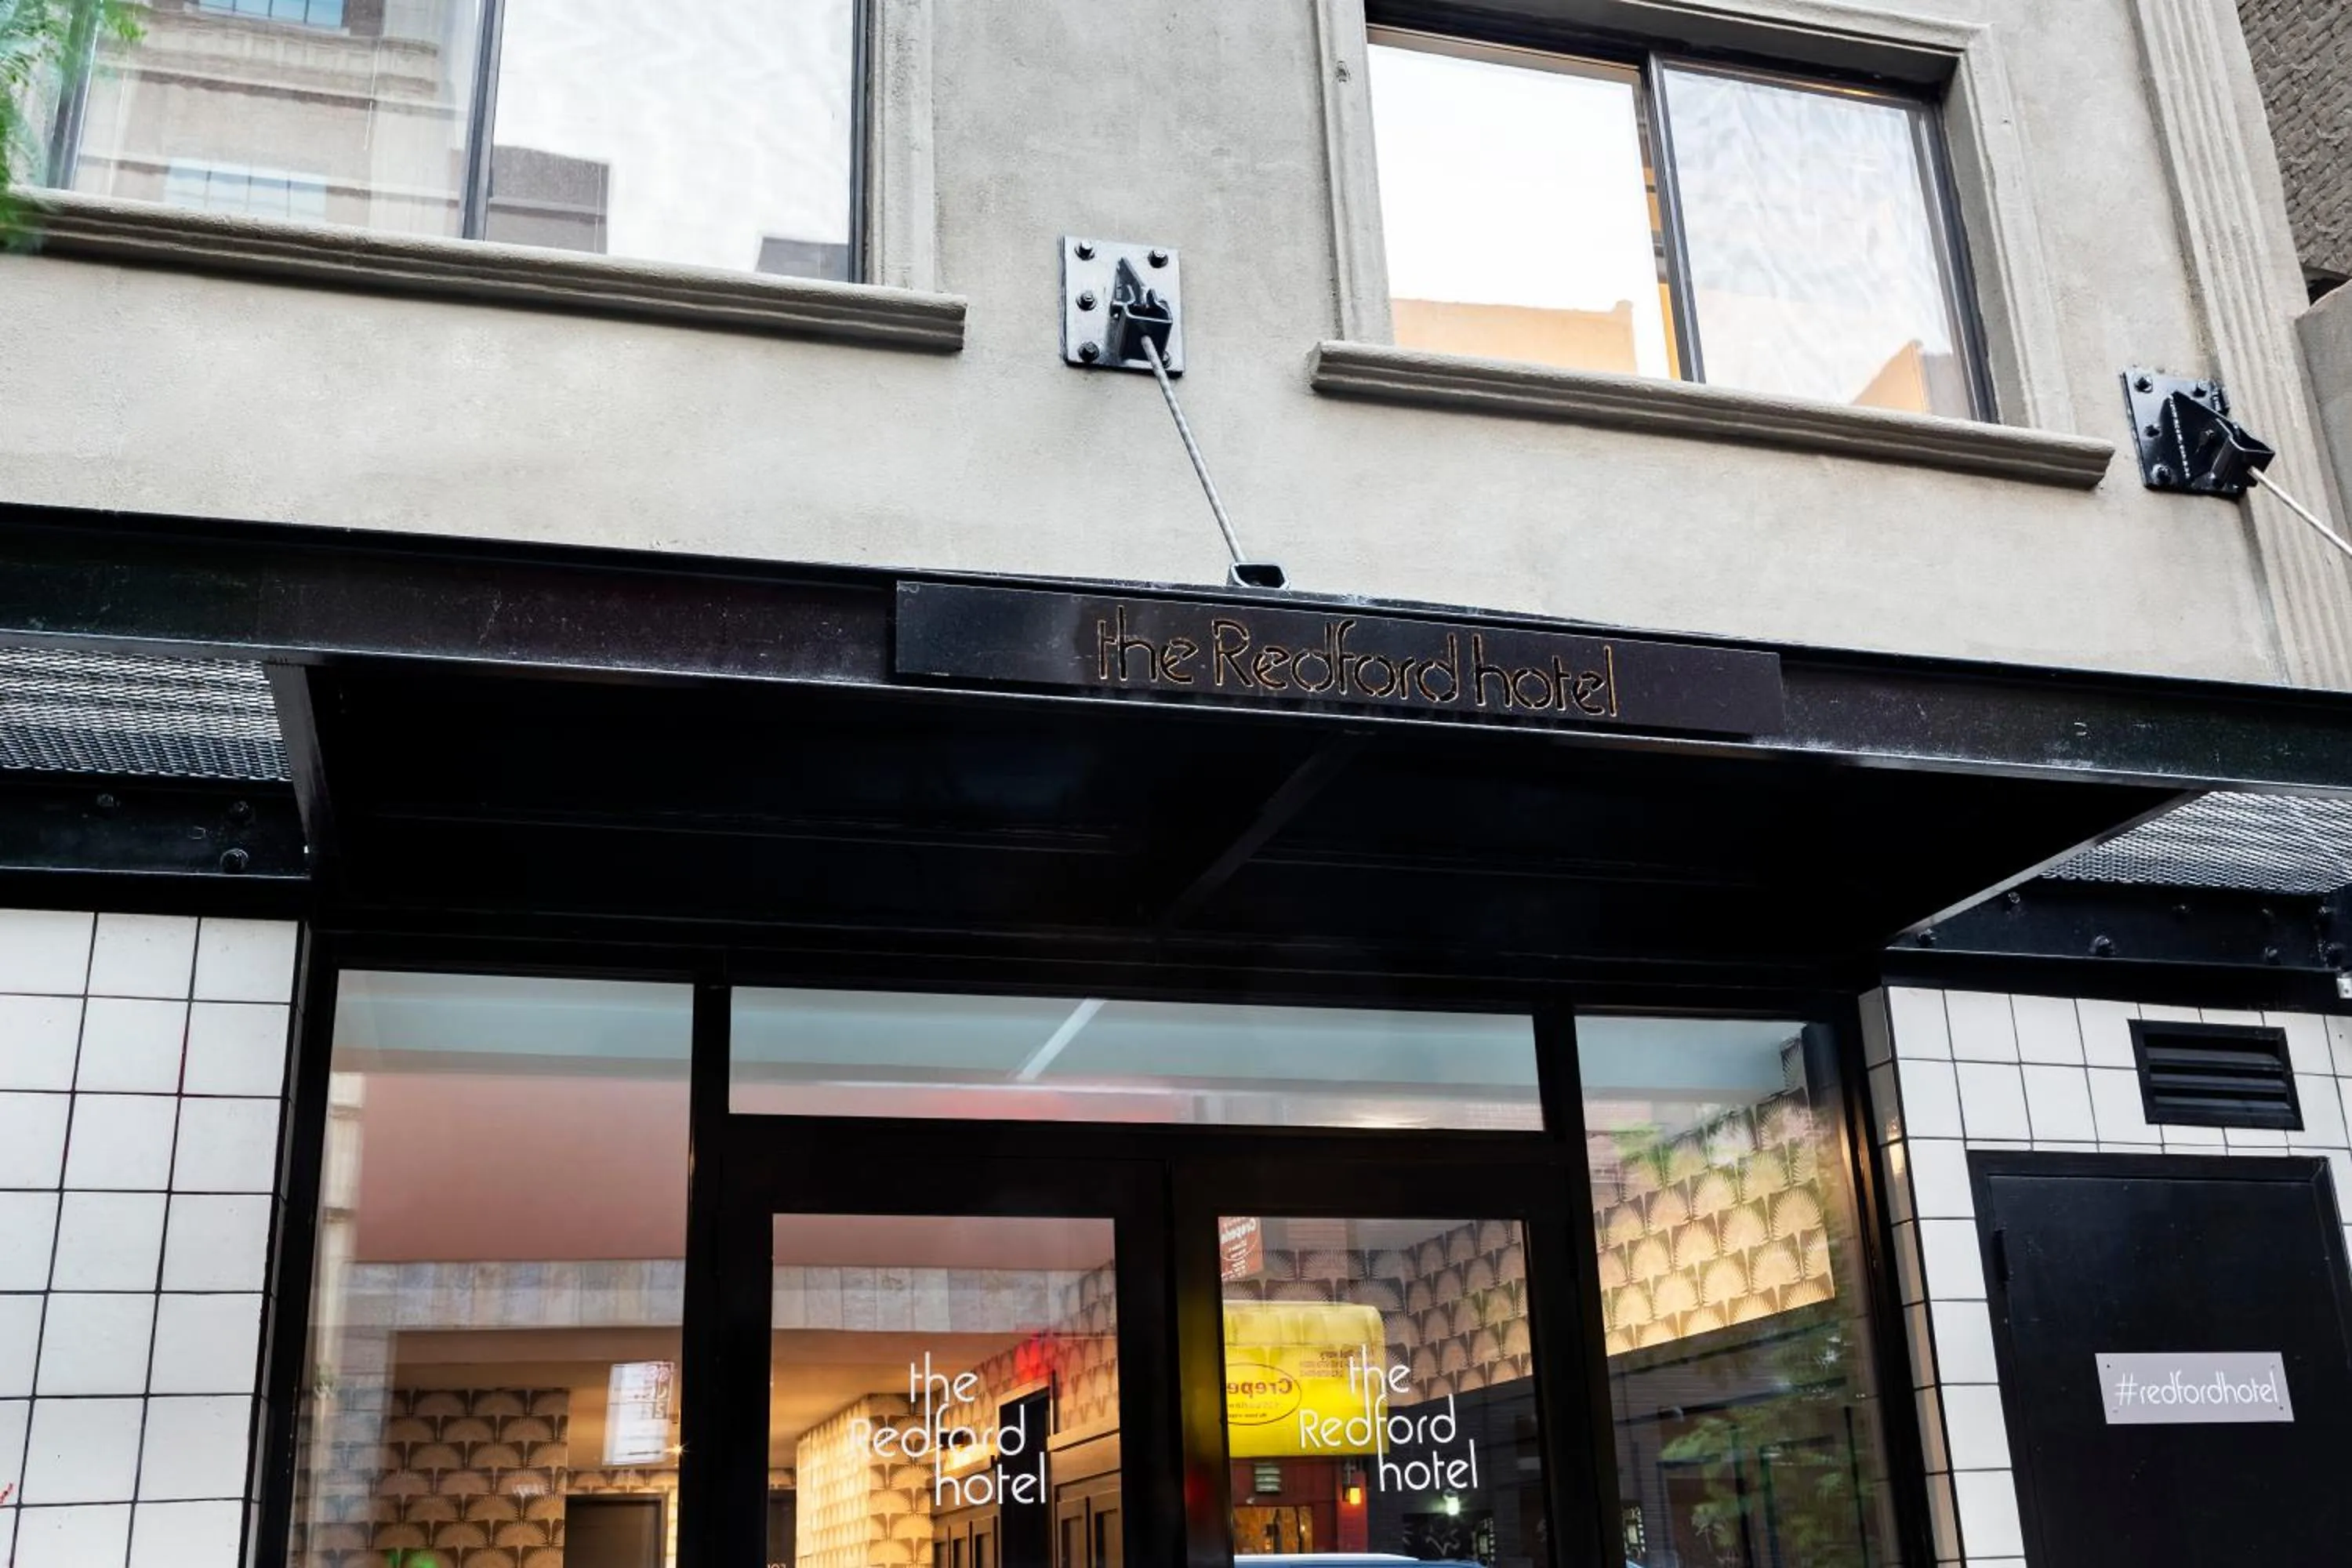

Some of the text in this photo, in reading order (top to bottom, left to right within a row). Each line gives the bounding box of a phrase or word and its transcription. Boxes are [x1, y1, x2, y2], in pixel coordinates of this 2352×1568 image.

[1098, 607, 1617, 717] the Redford hotel
[909, 1352, 979, 1403] the
[1348, 1345, 1411, 1395] the
[2114, 1370, 2278, 1406] #redfordhotel
[849, 1403, 1026, 1459] Redford
[1298, 1392, 1457, 1449] Redford
[935, 1451, 1047, 1506] hotel
[1378, 1439, 1479, 1492] hotel
